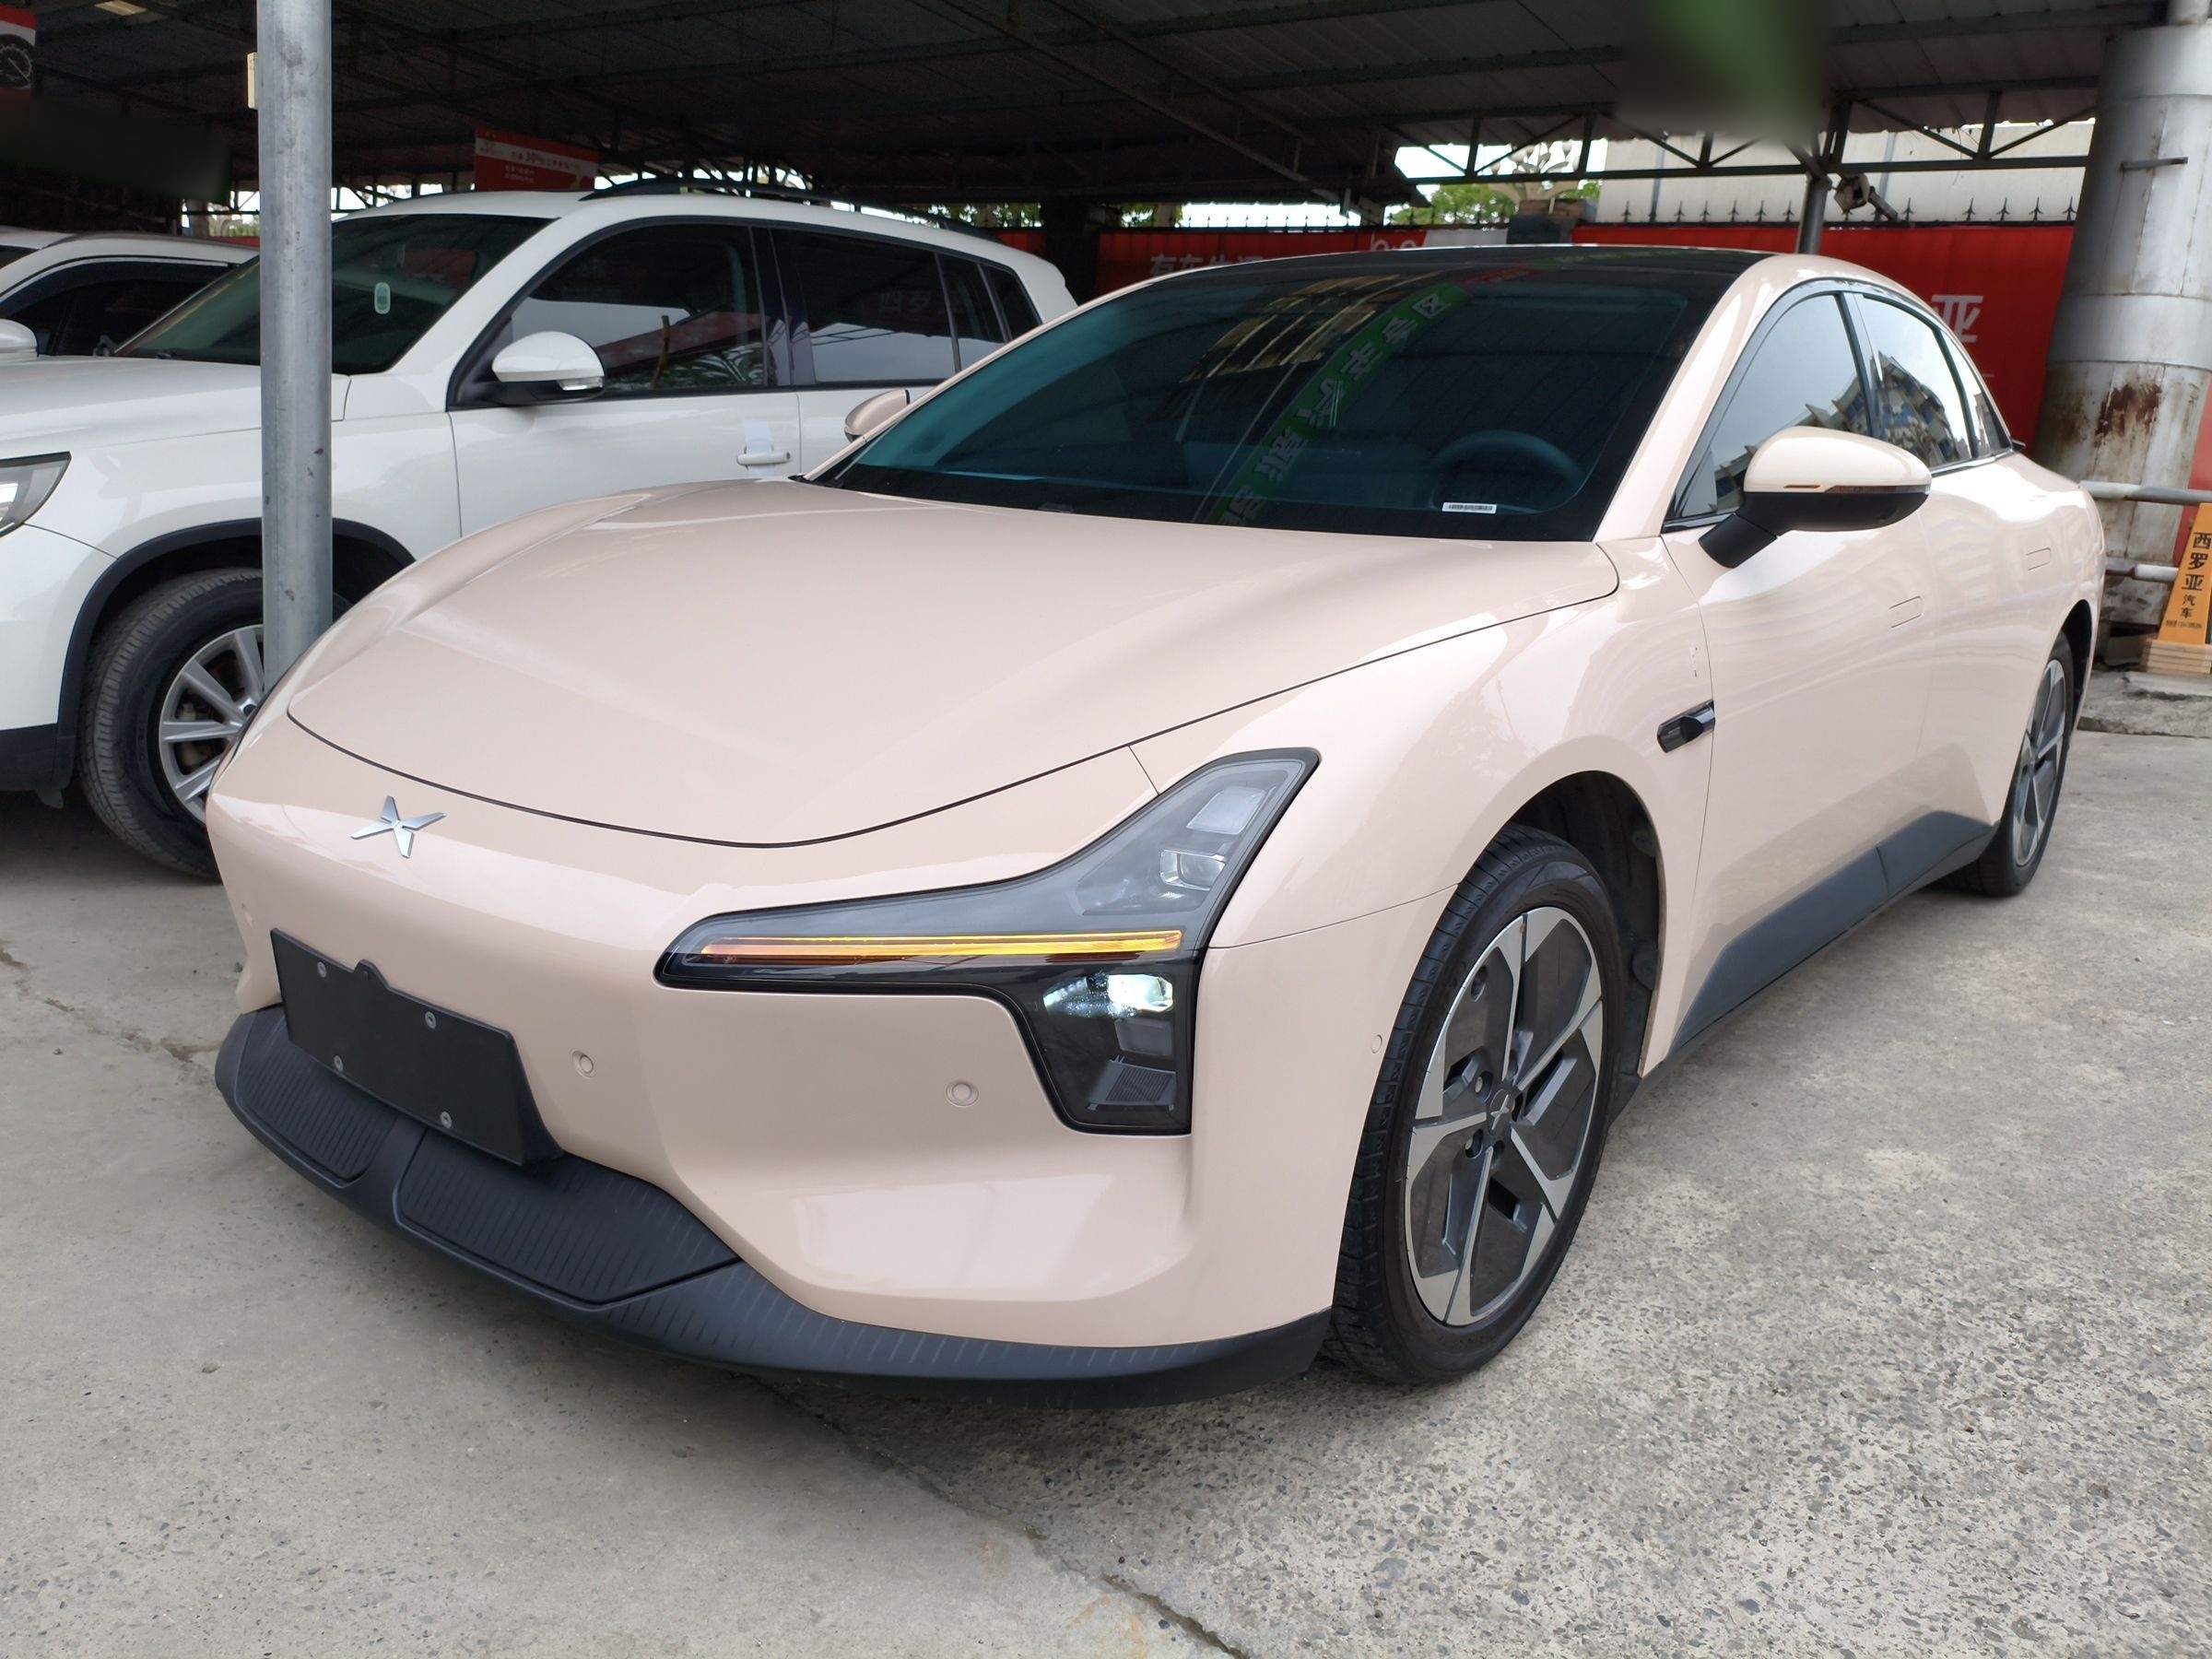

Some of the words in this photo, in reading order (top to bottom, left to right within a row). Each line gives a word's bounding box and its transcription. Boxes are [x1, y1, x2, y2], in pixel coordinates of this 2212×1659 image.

[2180, 532, 2212, 619] 西罗亚汽车
